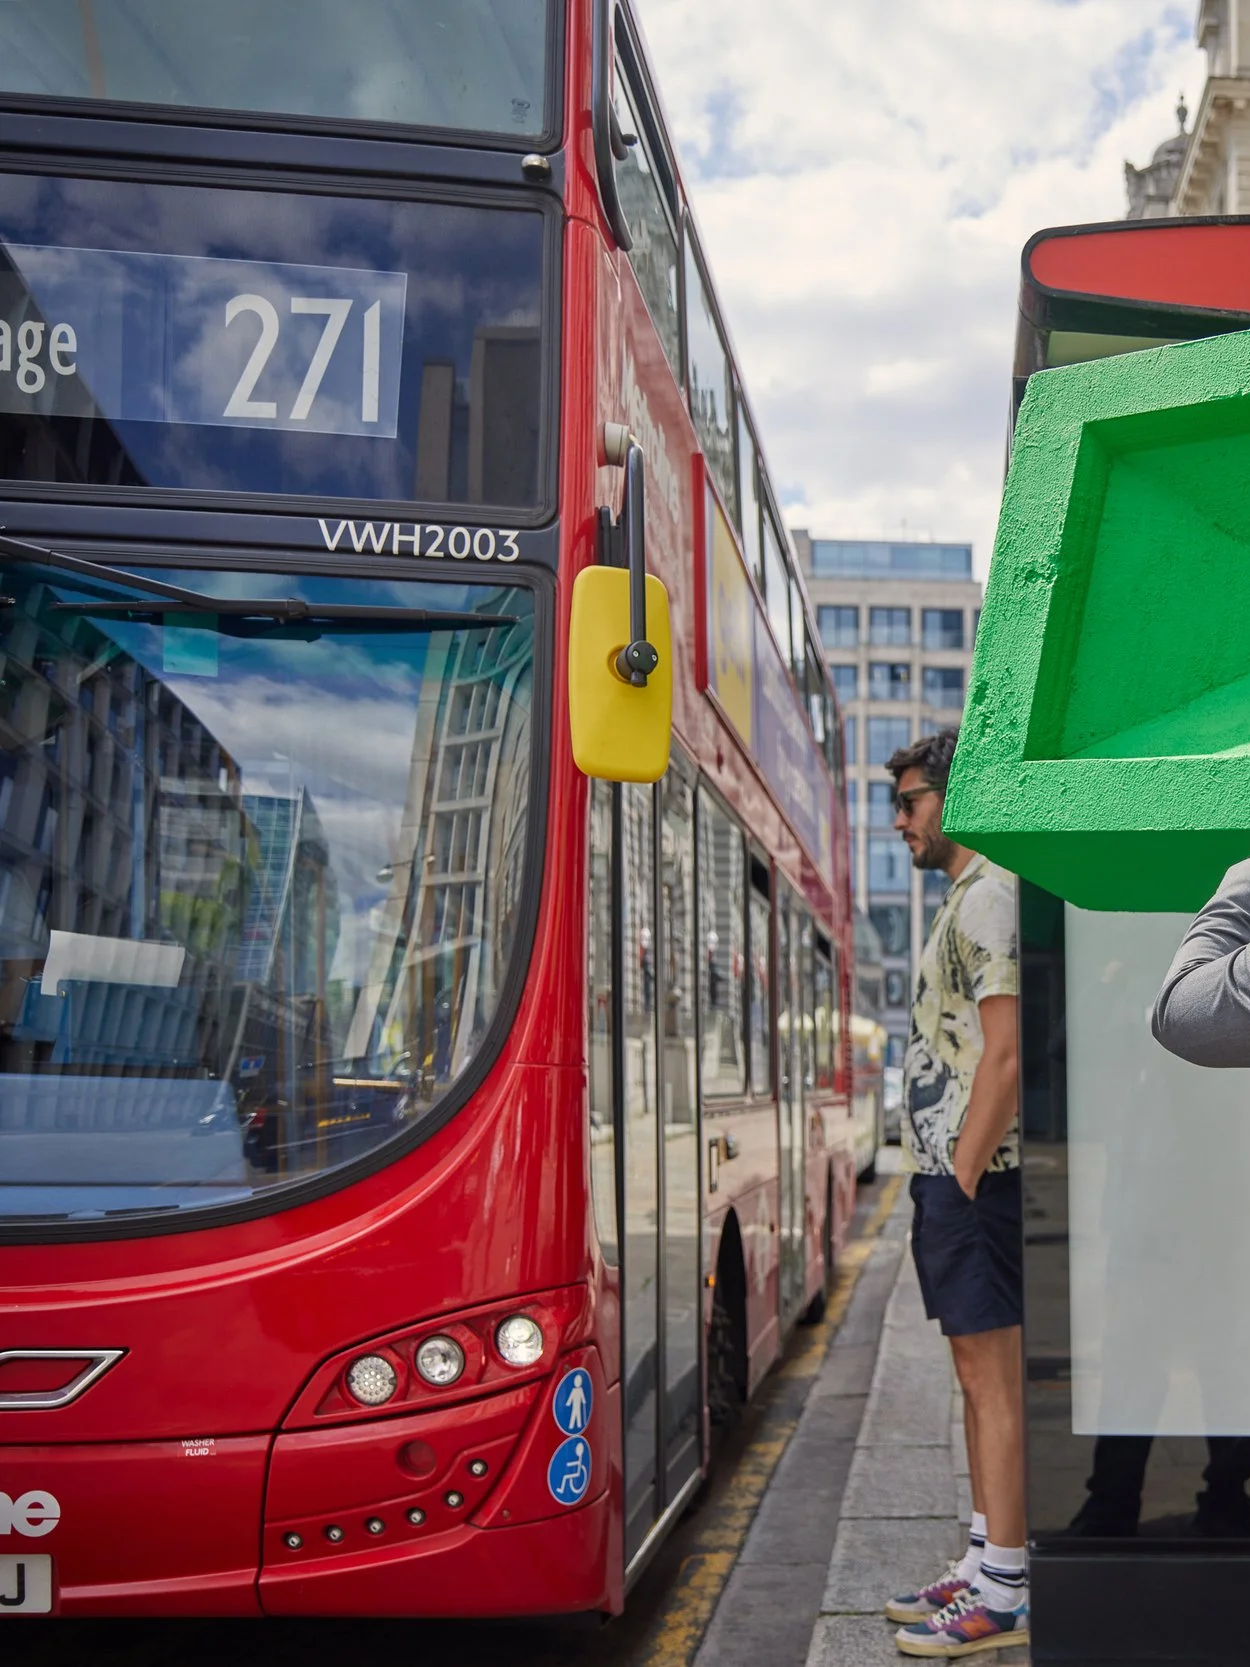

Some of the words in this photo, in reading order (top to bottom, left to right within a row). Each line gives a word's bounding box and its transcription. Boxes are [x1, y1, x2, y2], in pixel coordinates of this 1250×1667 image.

[223, 294, 380, 422] 271
[318, 519, 520, 562] VWH2003
[181, 1438, 215, 1448] WASHER
[185, 1448, 209, 1457] FLUID
